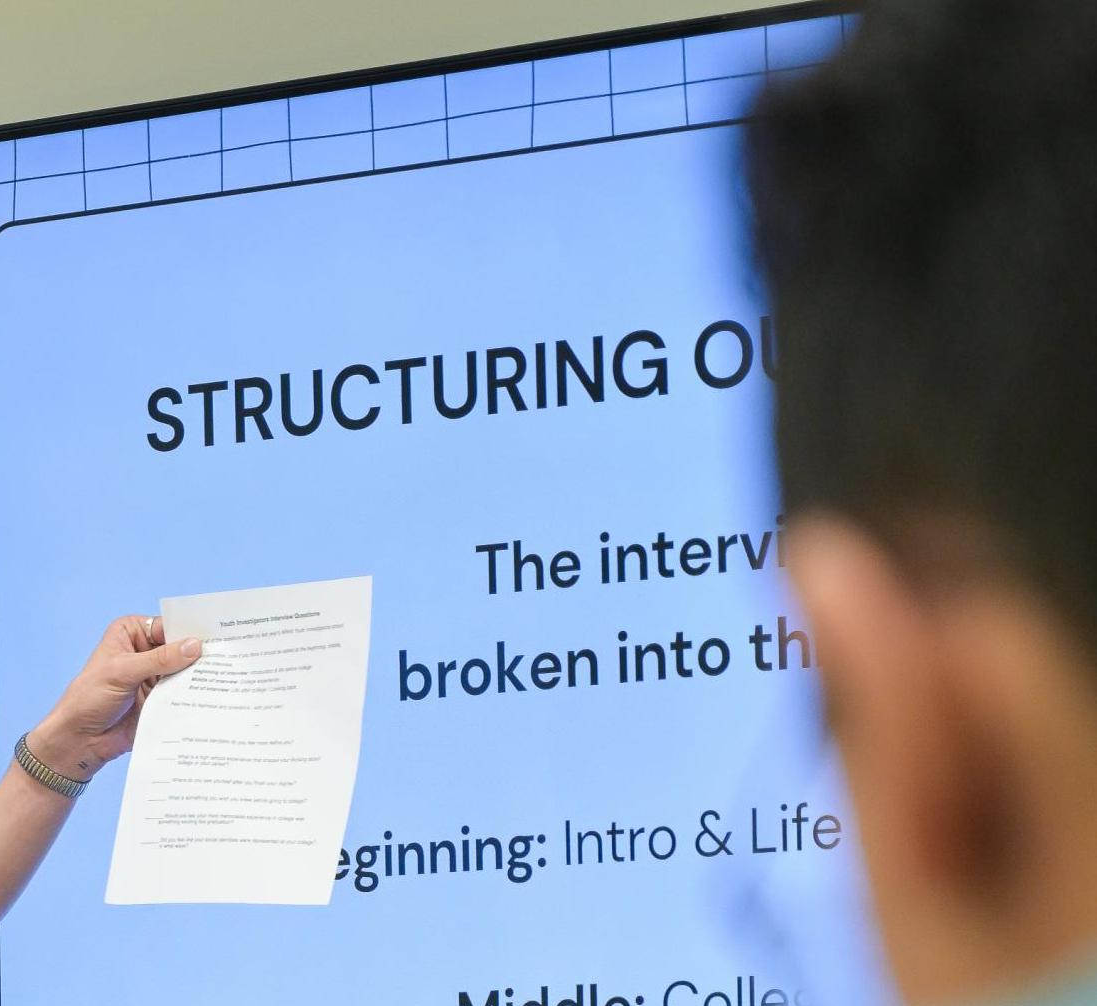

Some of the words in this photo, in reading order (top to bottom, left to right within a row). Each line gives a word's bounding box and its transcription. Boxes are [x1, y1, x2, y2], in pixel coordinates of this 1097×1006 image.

[146, 329, 669, 453] STRUCTURING
[475, 540, 581, 595] The
[399, 640, 599, 702] broken
[618, 630, 731, 684] into
[565, 819, 677, 866] Intro
[694, 809, 734, 857] &
[751, 801, 842, 853] Life
